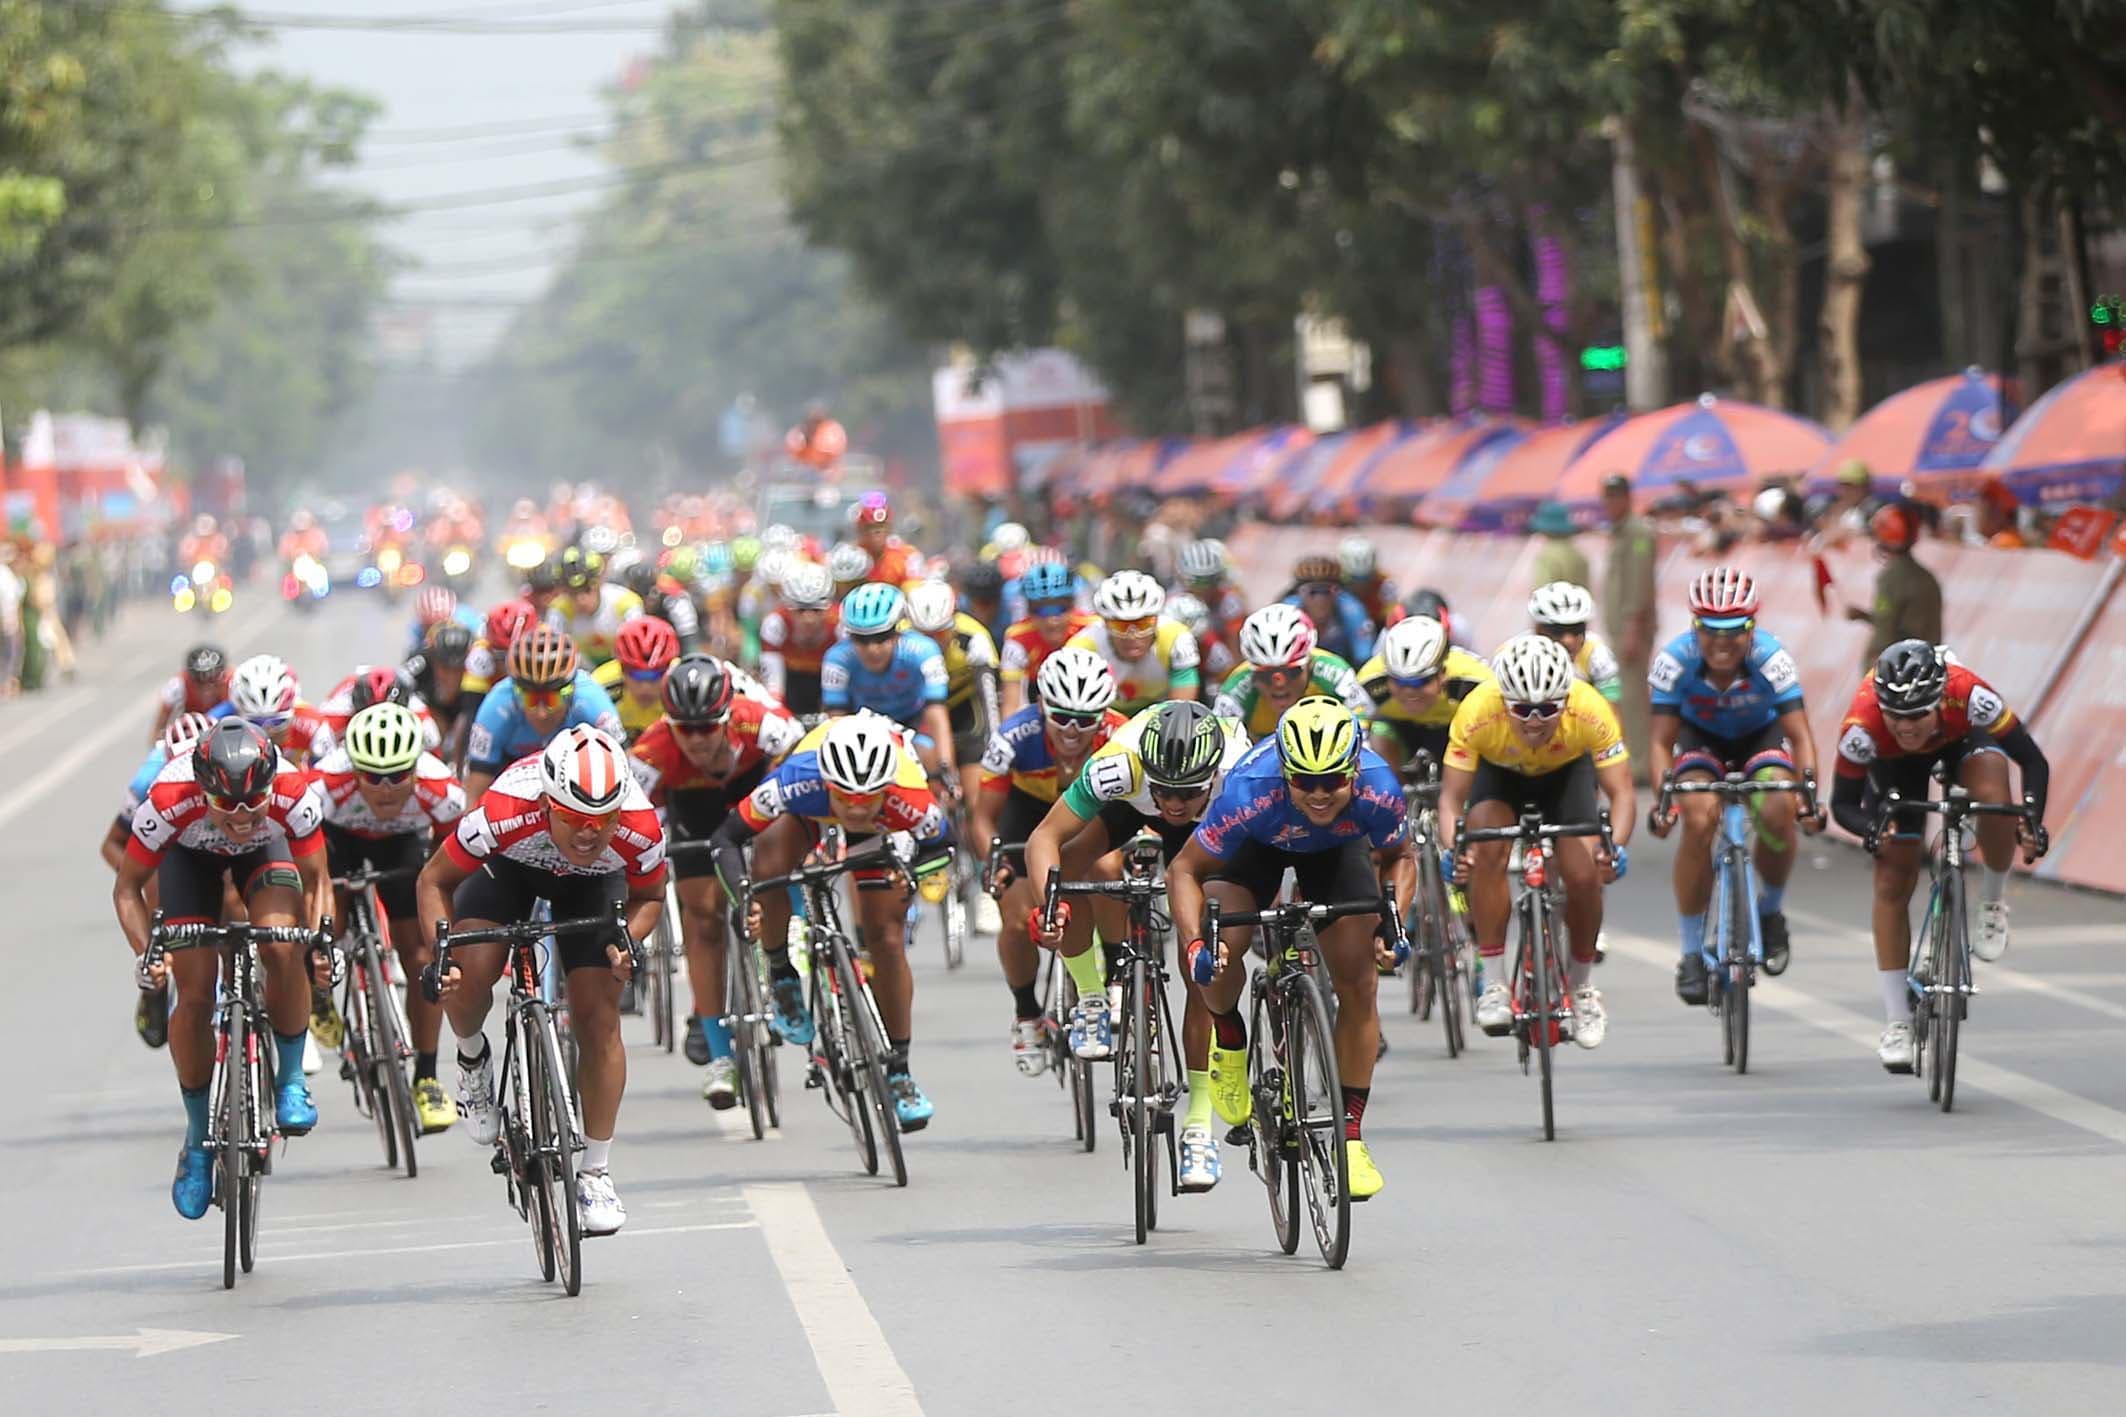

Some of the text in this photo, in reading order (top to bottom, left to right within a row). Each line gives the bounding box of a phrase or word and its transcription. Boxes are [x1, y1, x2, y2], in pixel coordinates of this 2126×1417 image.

[1973, 696, 1996, 720] 86
[303, 806, 319, 824] 2
[139, 818, 157, 838] 2
[464, 830, 481, 844] 1
